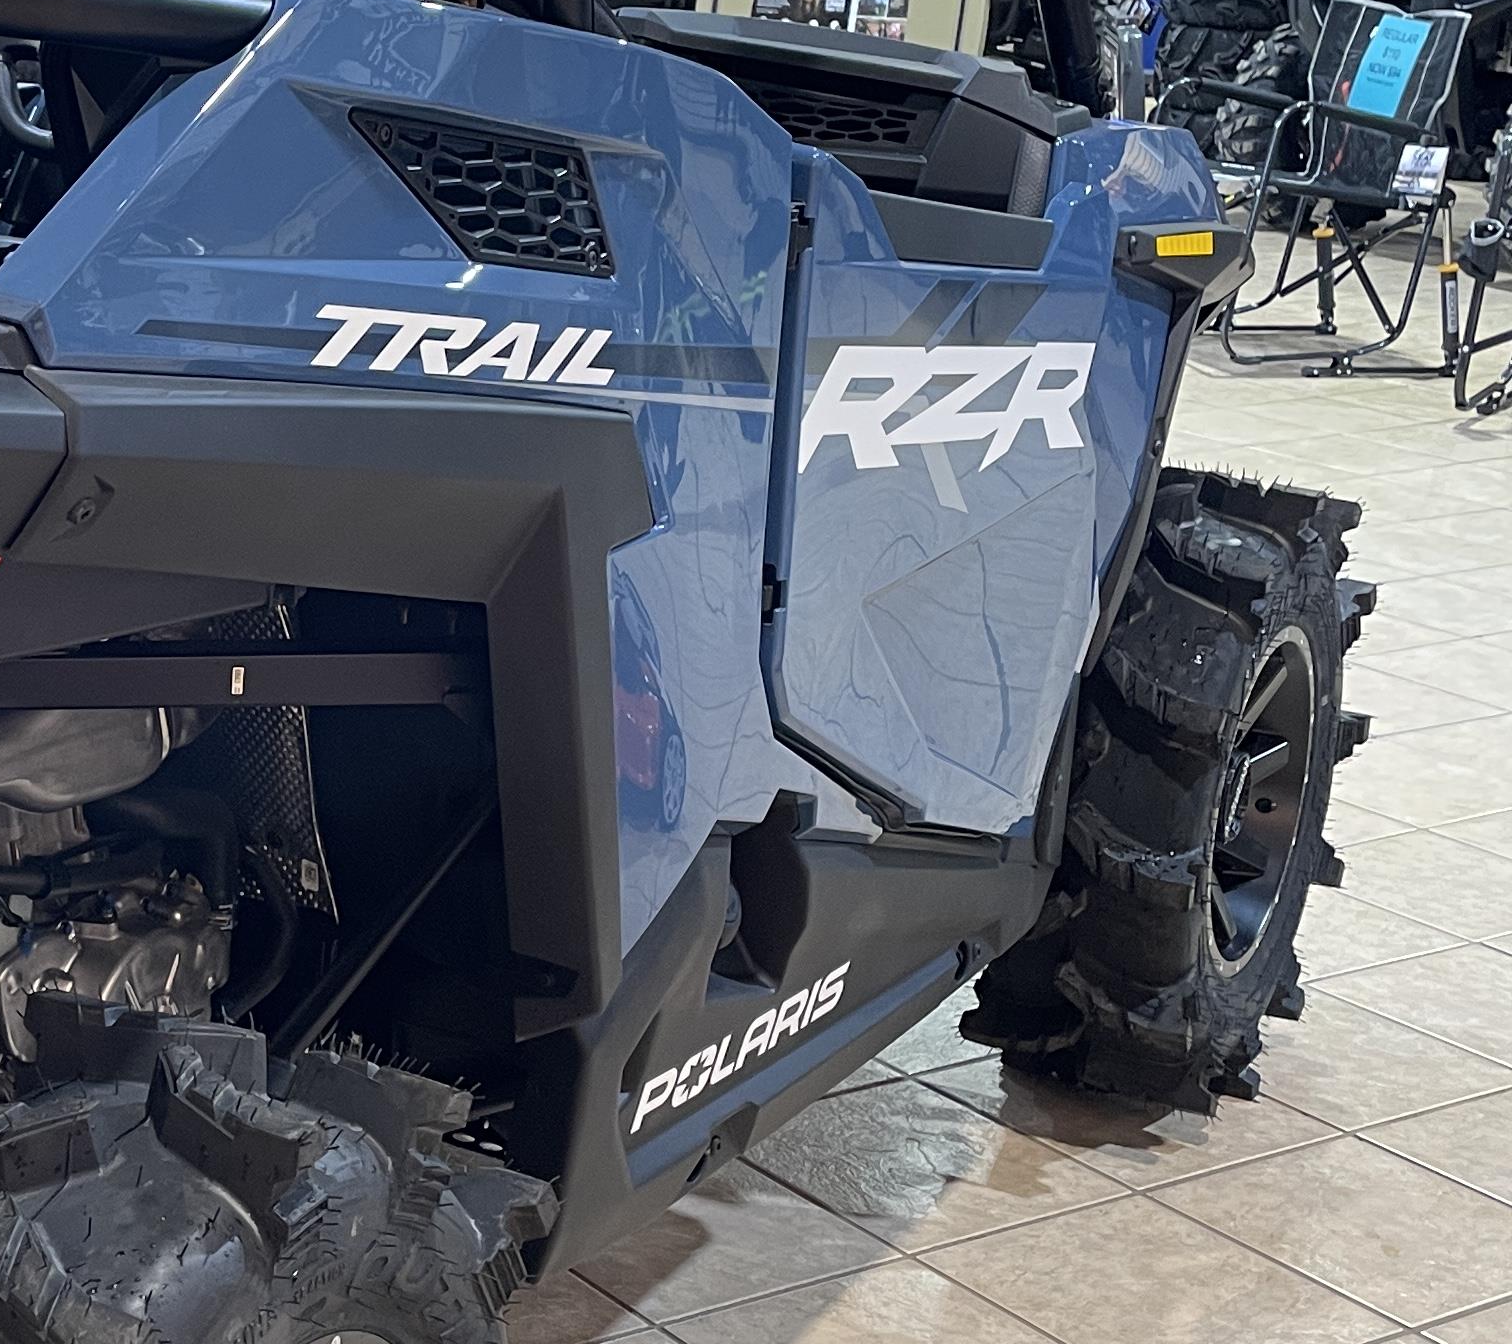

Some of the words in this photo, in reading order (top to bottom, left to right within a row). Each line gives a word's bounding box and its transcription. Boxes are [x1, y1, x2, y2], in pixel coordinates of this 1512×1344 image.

[310, 304, 616, 387] TRAIL
[797, 340, 1096, 474] RZR
[629, 960, 851, 1135] POLARIS
